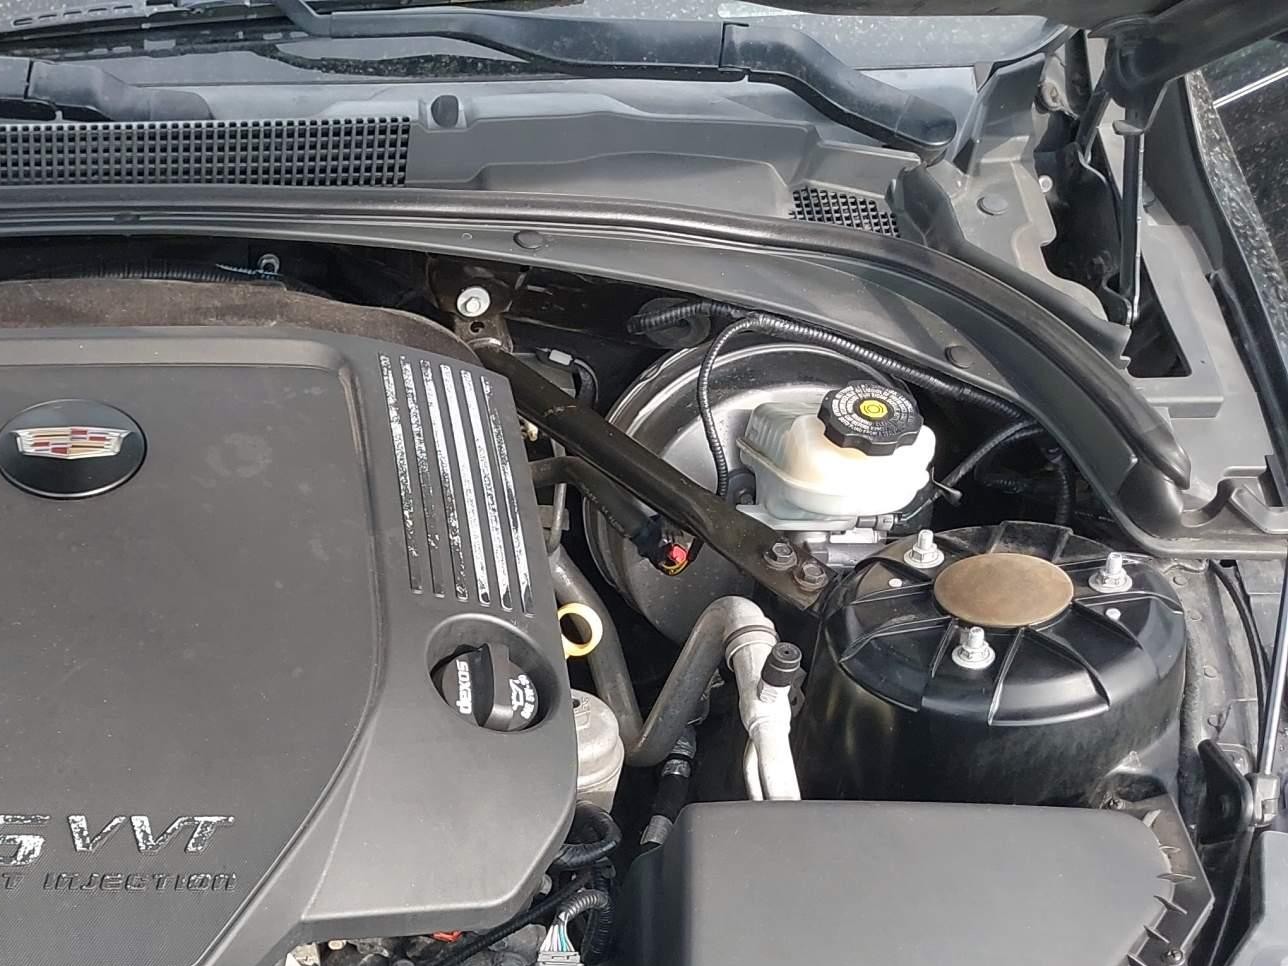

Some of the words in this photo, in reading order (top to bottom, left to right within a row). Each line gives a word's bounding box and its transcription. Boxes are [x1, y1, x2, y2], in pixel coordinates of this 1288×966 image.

[455, 659, 472, 715] dexos
[67, 814, 235, 853] VVT
[43, 871, 237, 891] INJECTION
